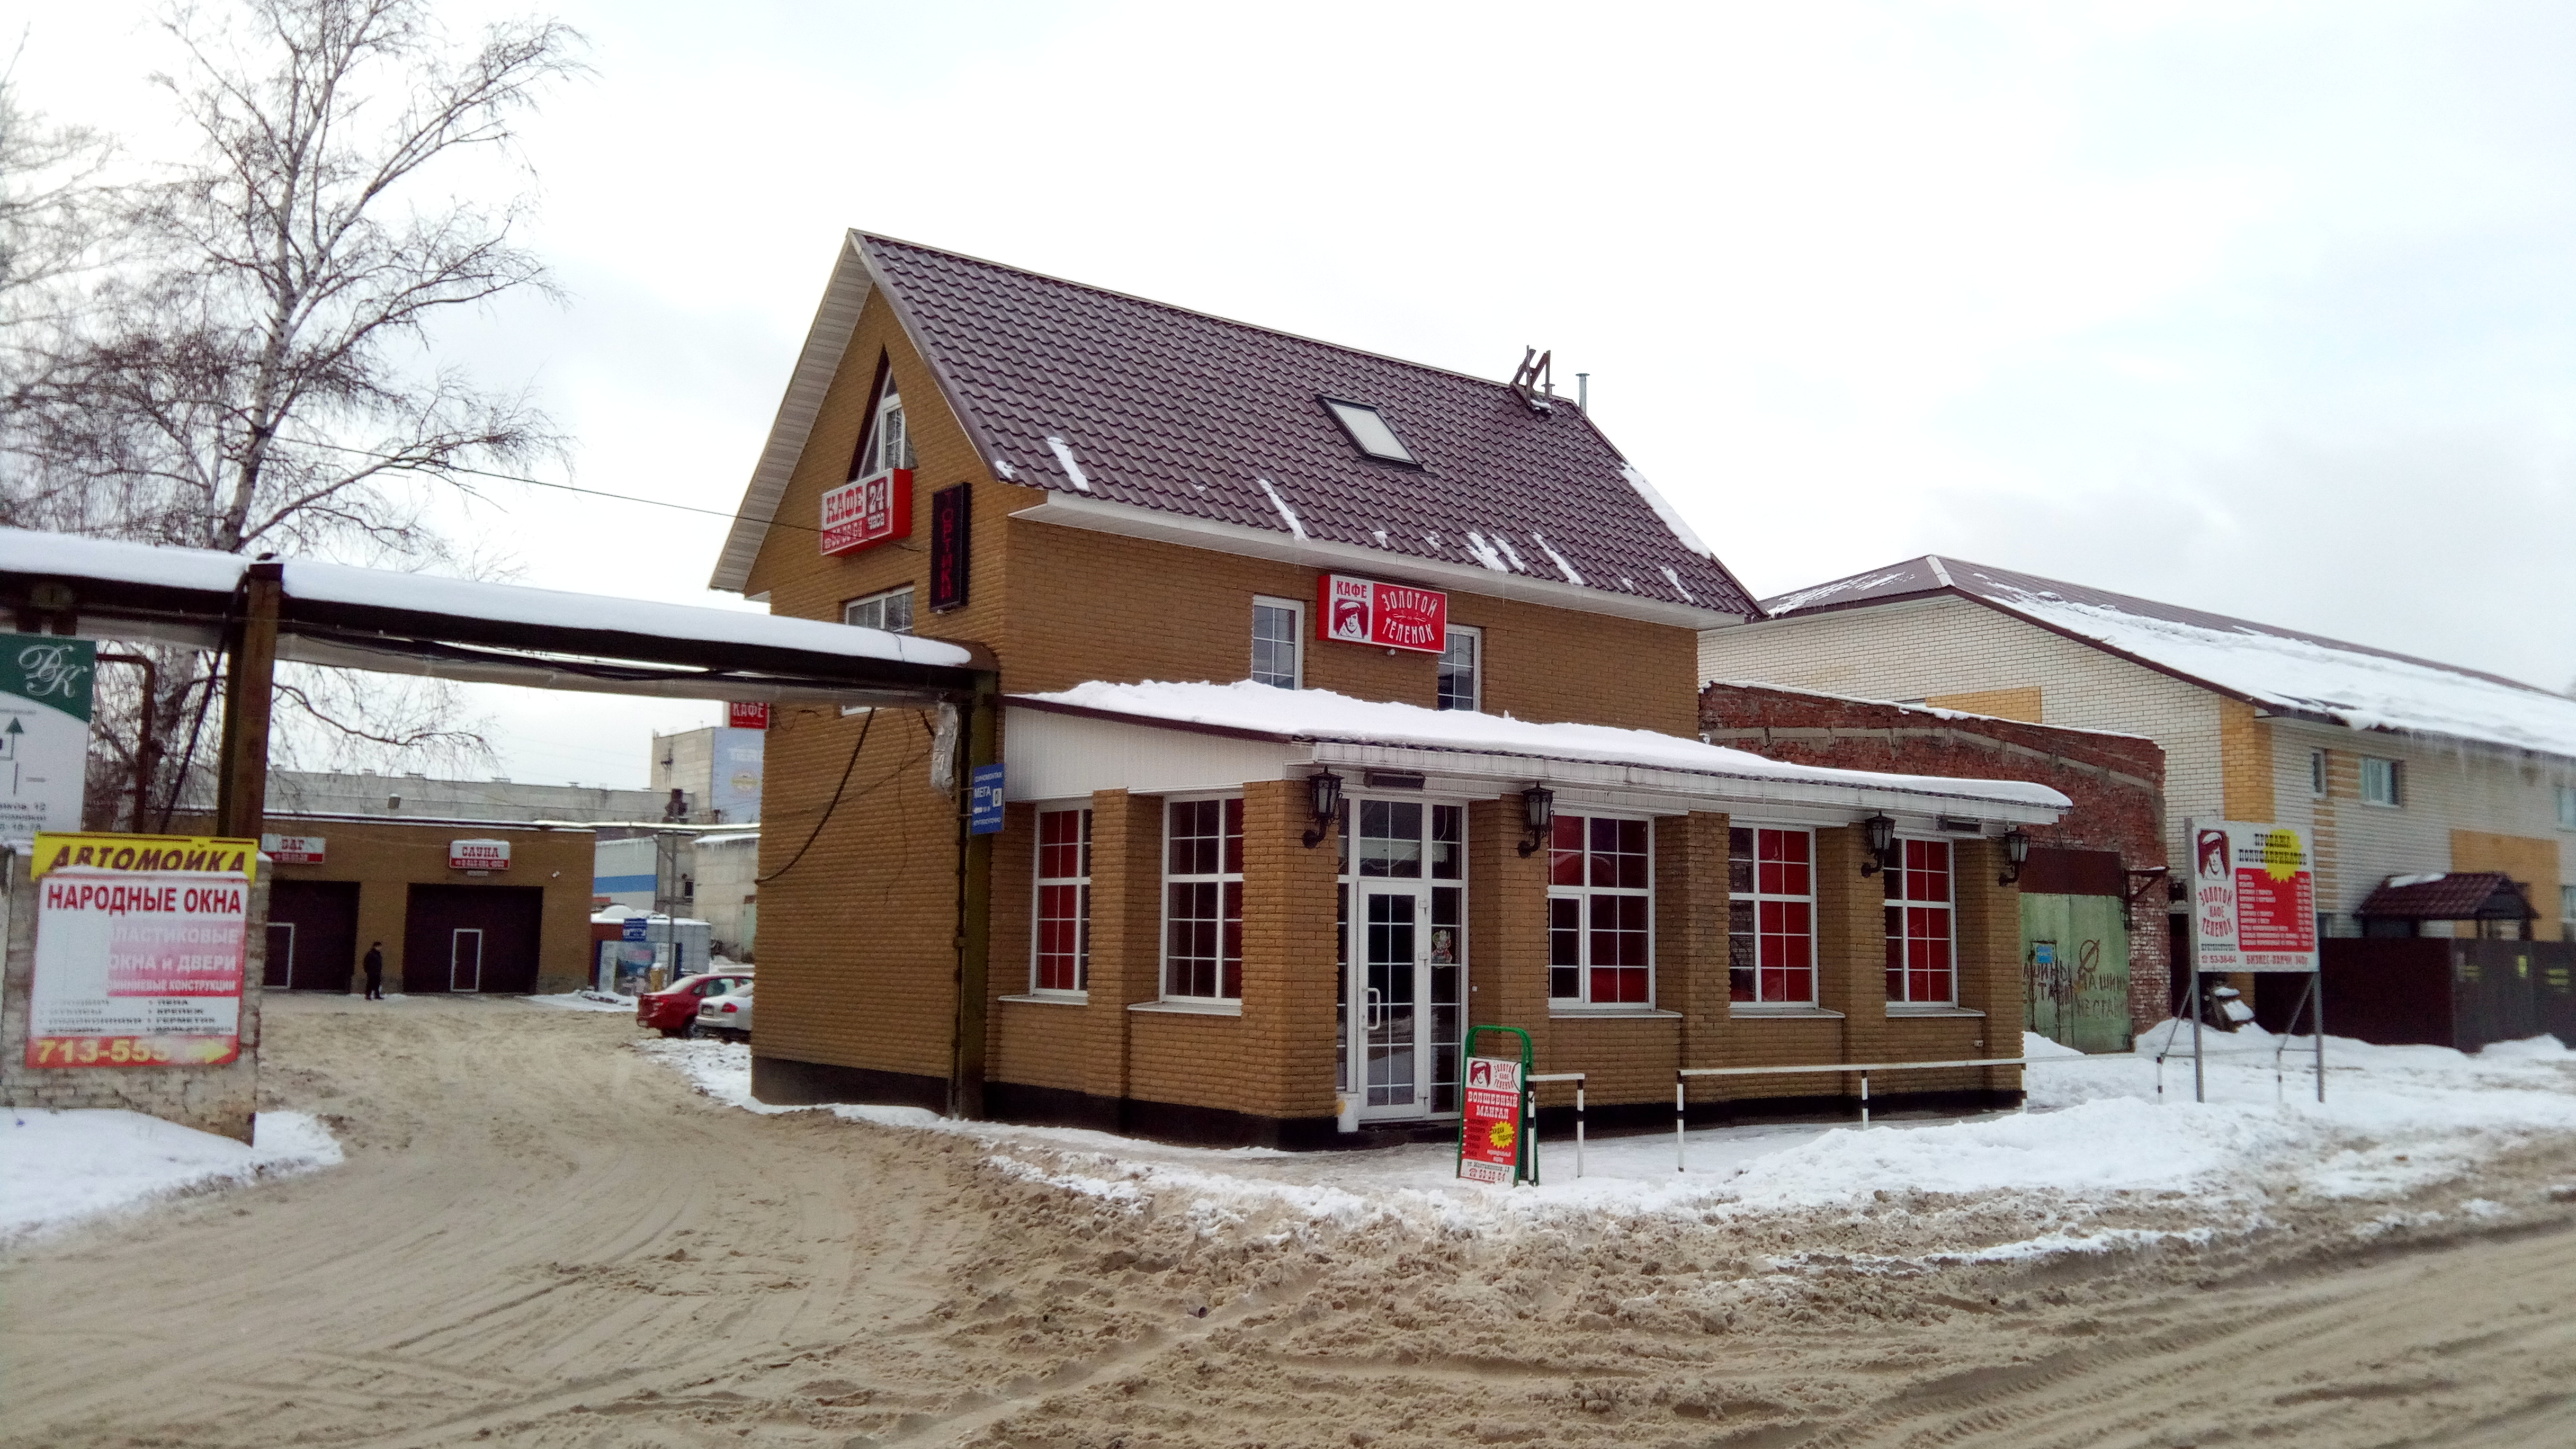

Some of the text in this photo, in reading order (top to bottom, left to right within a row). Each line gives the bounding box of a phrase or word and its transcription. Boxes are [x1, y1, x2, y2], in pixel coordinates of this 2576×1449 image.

[827, 486, 863, 524] КАФЕ
[869, 482, 884, 514] 24
[1336, 580, 1367, 599] КАФЕ
[1381, 591, 1438, 618] ЗОЛОТОЙ
[1382, 617, 1435, 644] ТЕЛЕНОК
[974, 785, 991, 798] МЕГА
[48, 843, 245, 872] АВТОМОЙКА
[462, 846, 499, 858] САУНА
[47, 884, 241, 917] НАРОДНЫЕ ОКНА
[2199, 886, 2233, 907] ЗОЛОТОЙ
[108, 954, 156, 971] ОКНА
[177, 954, 235, 973] ДВЕРИ
[168, 980, 235, 991] КОНСТРУКЦИИ
[35, 1039, 172, 1064] 713-555
[1468, 1091, 1517, 1107] ВОЛШЕБНЫЙ
[1476, 1105, 1509, 1120] МАНГАЛ
